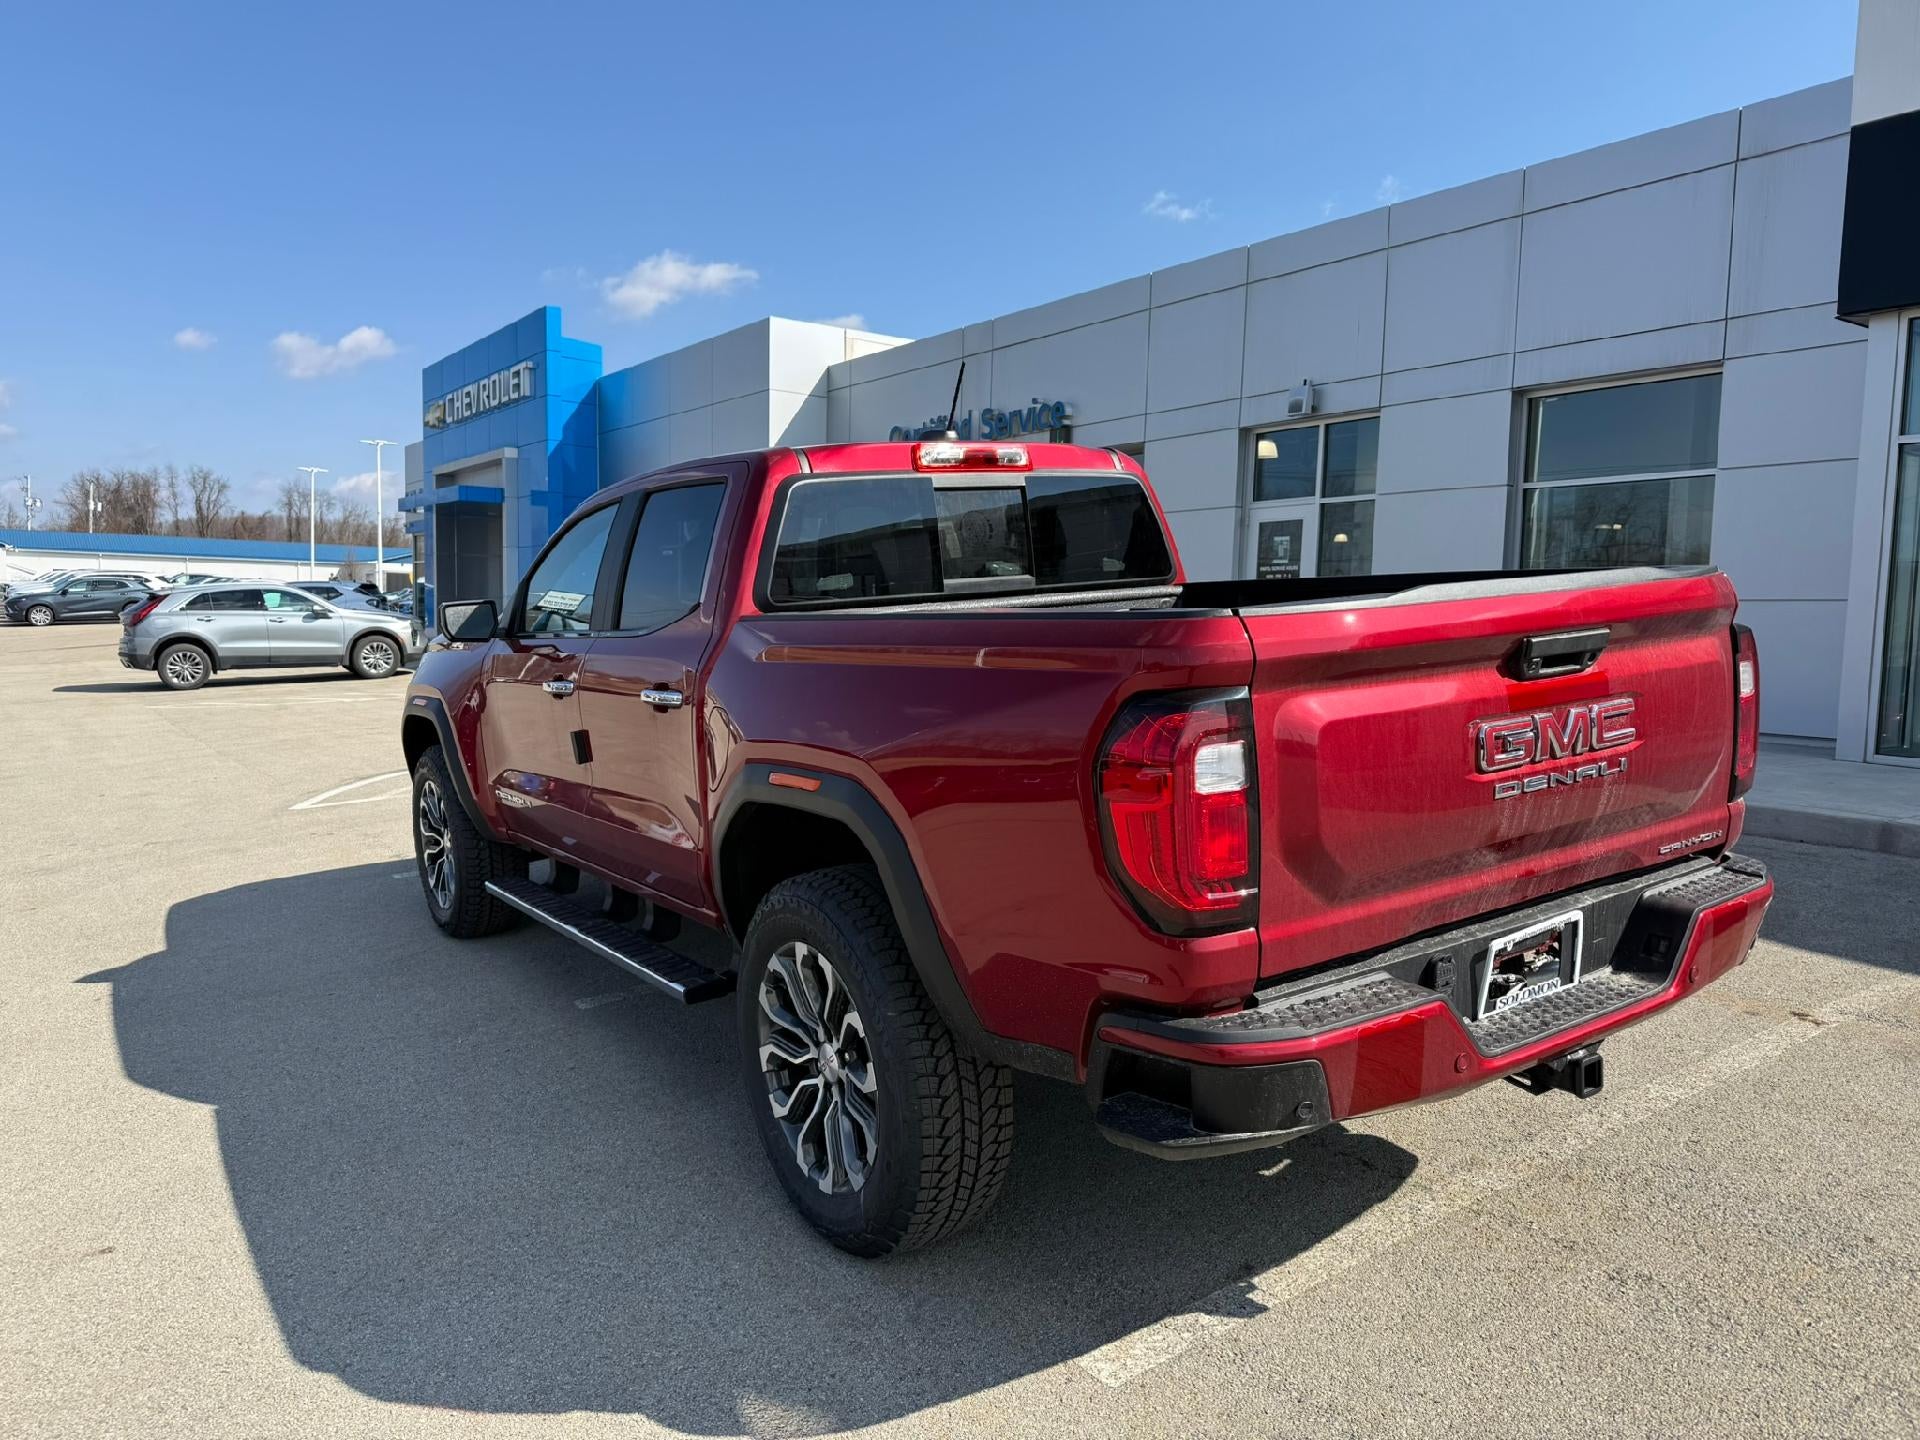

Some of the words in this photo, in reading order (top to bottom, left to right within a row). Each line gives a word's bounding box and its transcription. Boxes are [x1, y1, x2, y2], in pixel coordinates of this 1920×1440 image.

[445, 361, 534, 424] CHEVROLET
[981, 397, 1068, 440] Service
[1477, 698, 1637, 773] GMC
[1494, 757, 1628, 800] DENALI
[1659, 829, 1722, 854] CANYON
[1498, 979, 1560, 1007] SOLOMON
